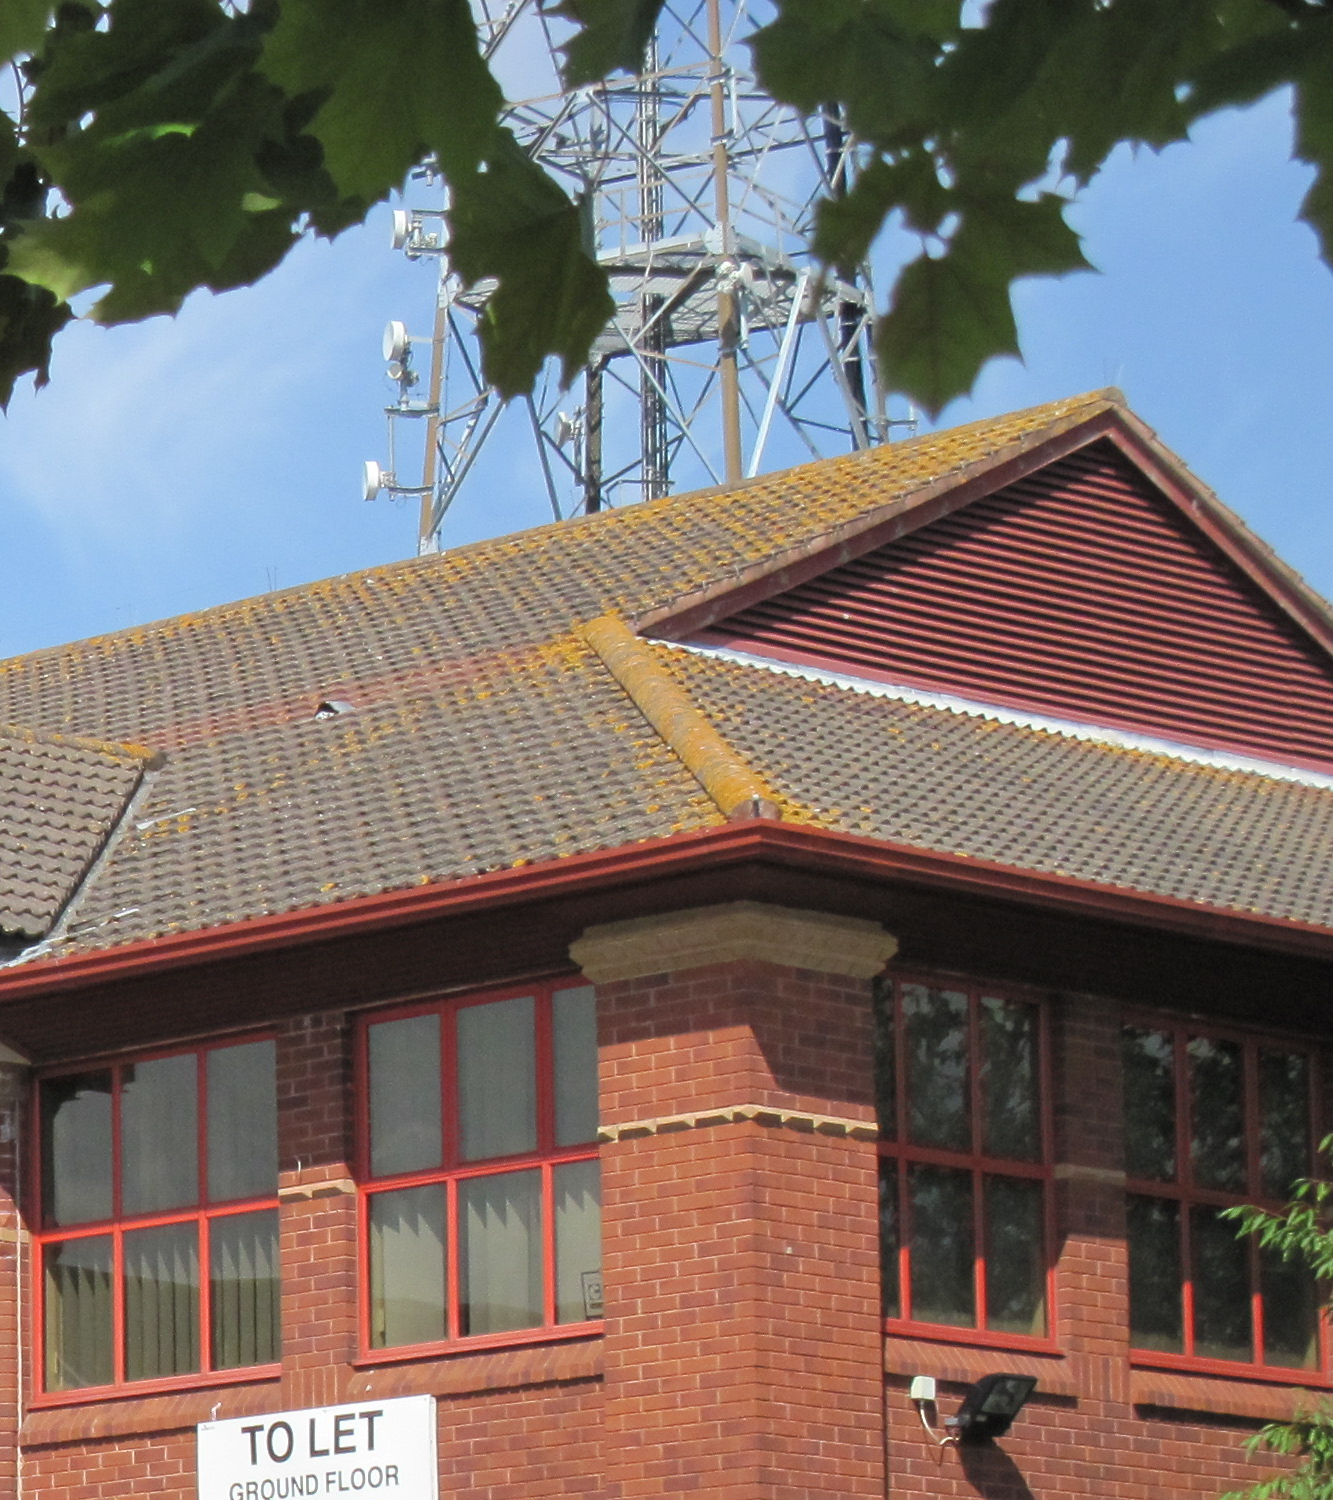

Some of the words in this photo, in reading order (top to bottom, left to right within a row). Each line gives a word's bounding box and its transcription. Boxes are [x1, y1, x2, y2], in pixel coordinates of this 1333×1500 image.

[241, 1420, 294, 1466] TO
[309, 1410, 383, 1458] LET
[326, 1465, 399, 1493] FLOOR
